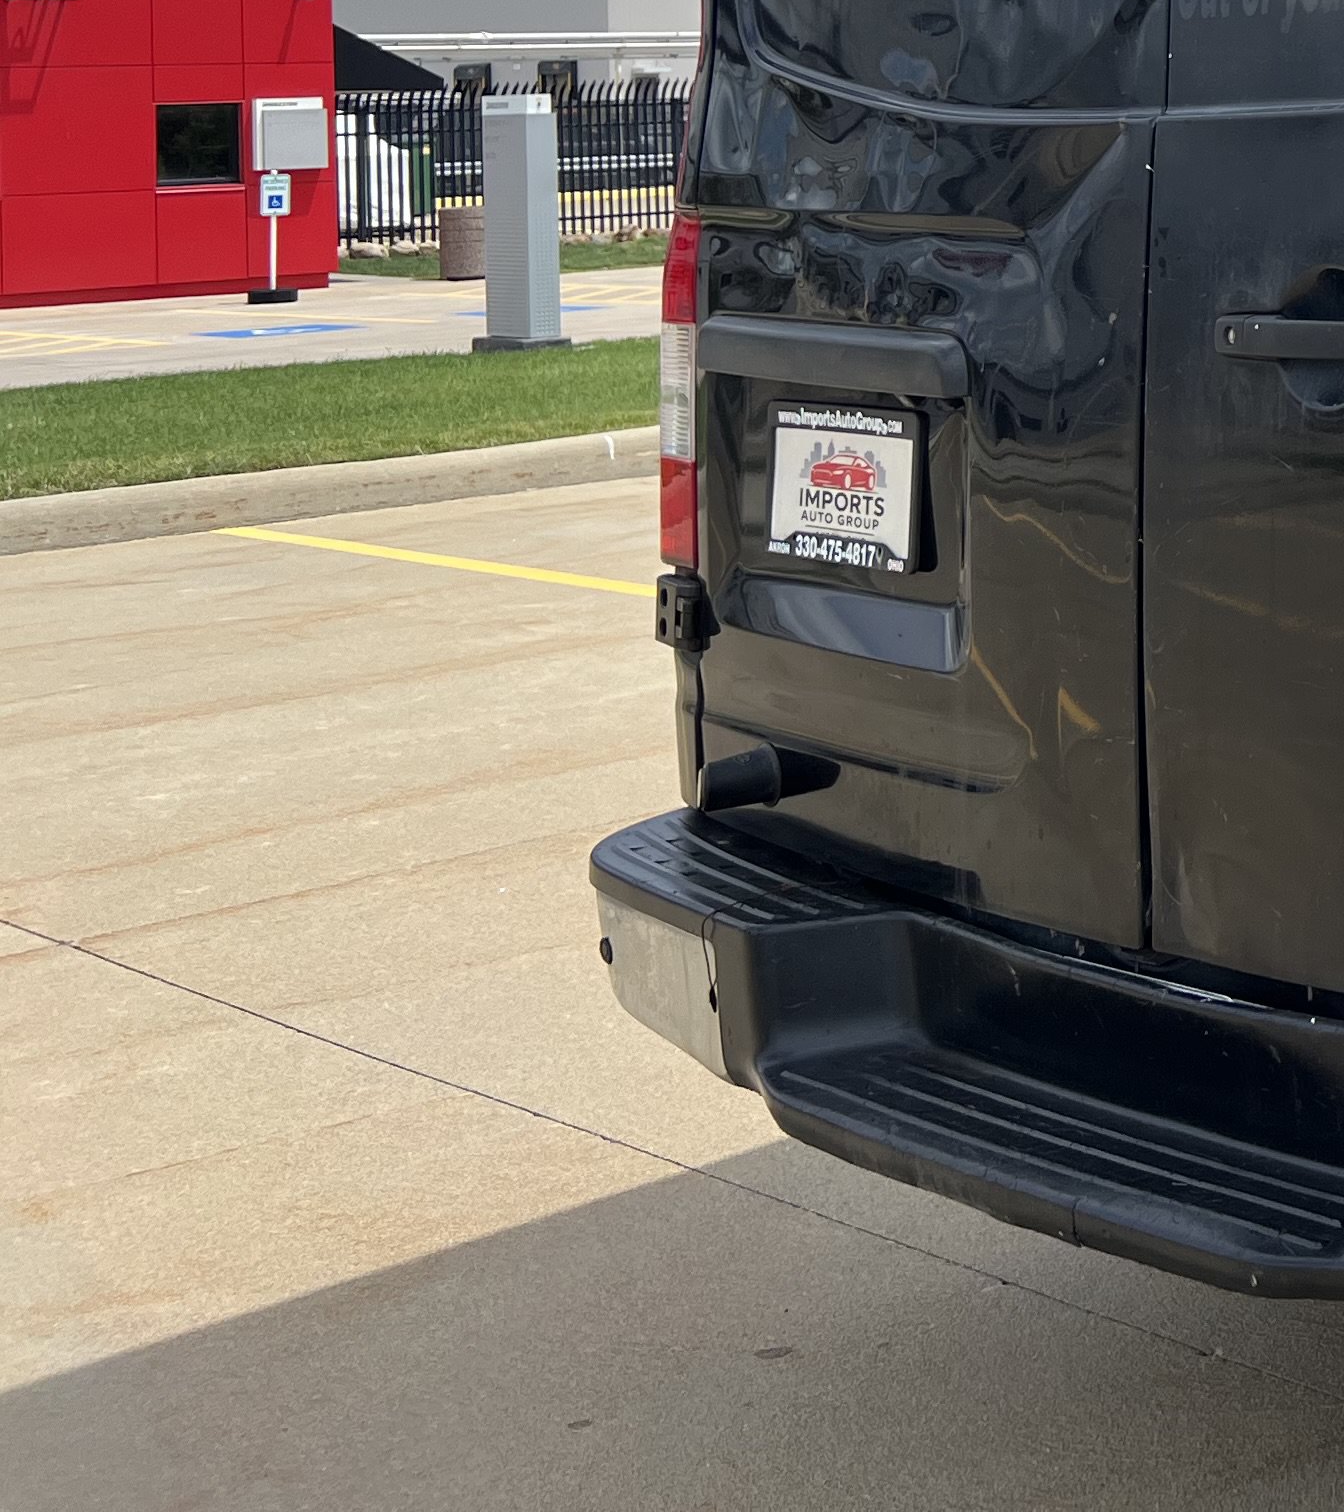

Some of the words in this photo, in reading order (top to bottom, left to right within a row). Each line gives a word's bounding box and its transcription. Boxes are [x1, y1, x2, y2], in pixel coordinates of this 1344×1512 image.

[799, 487, 885, 518] IMPORTS
[800, 509, 833, 525] AUTO
[837, 514, 879, 531] GROUP
[795, 534, 877, 568] 330-475-4817
